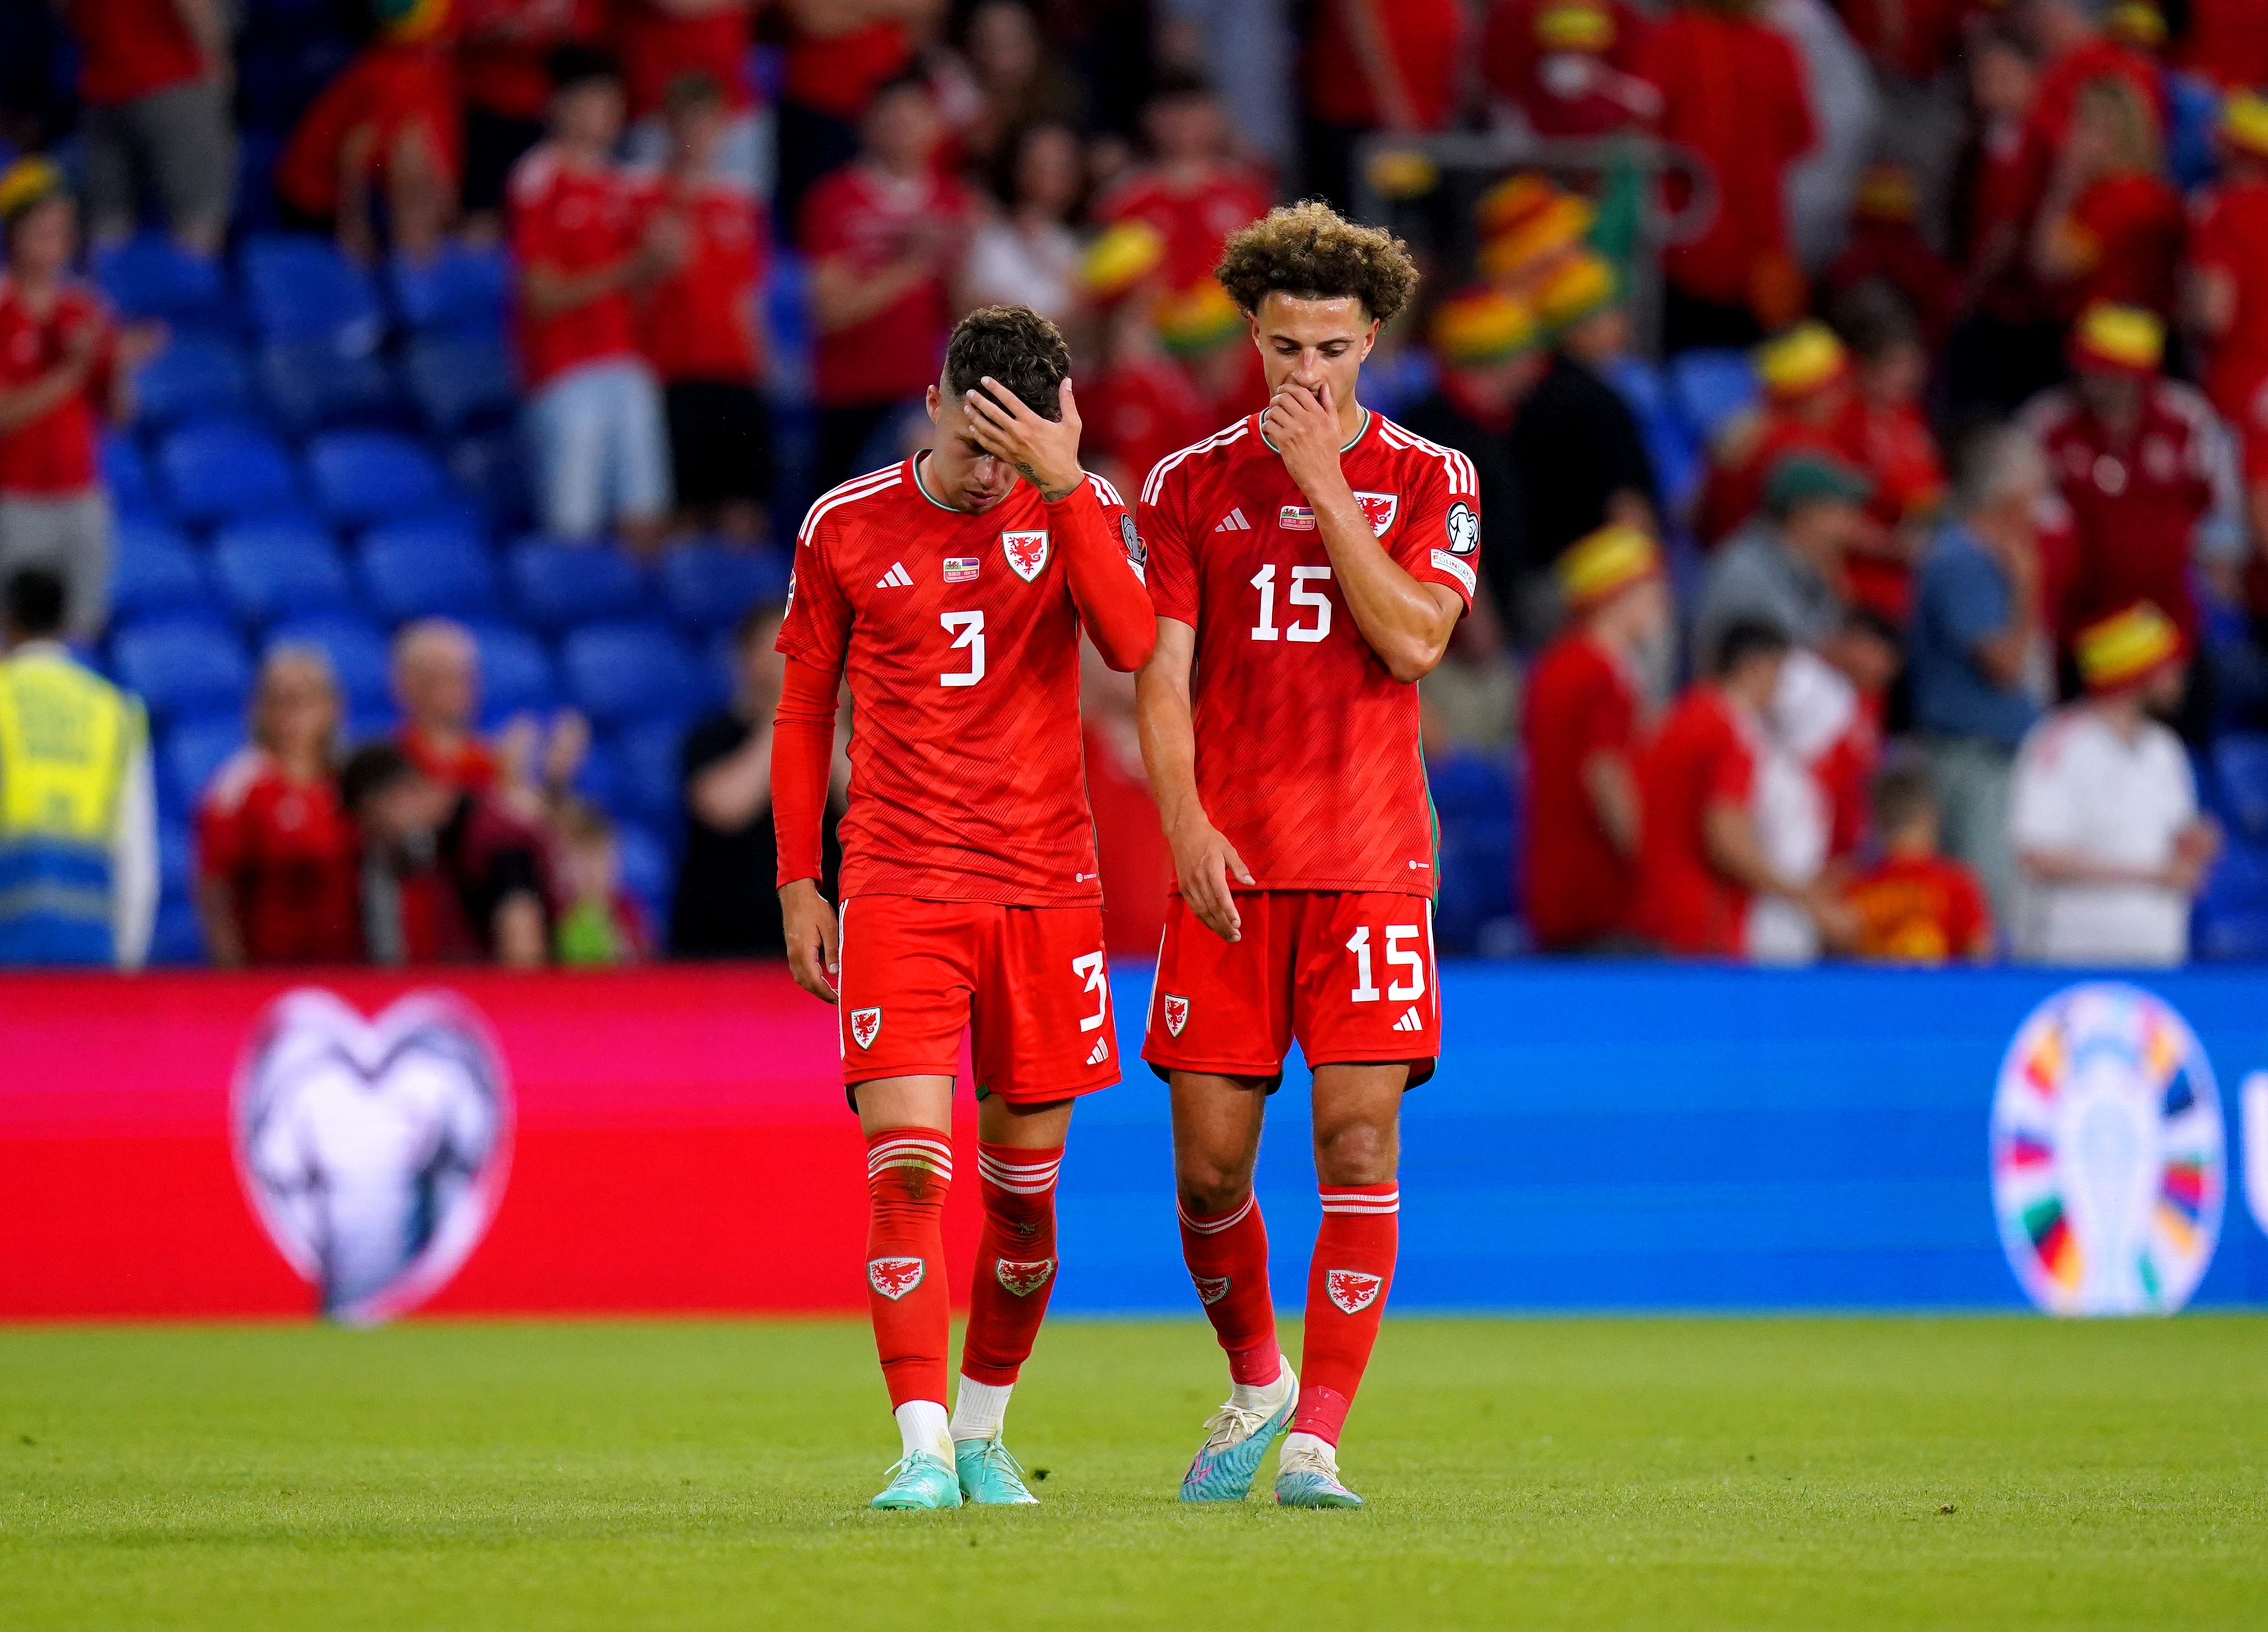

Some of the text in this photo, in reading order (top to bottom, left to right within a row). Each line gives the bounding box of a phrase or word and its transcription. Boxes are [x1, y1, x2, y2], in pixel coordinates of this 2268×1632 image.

[1250, 564, 1332, 642] 15
[940, 610, 985, 687] 3
[1072, 950, 1108, 1032] 3
[1345, 924, 1425, 1002] 15
